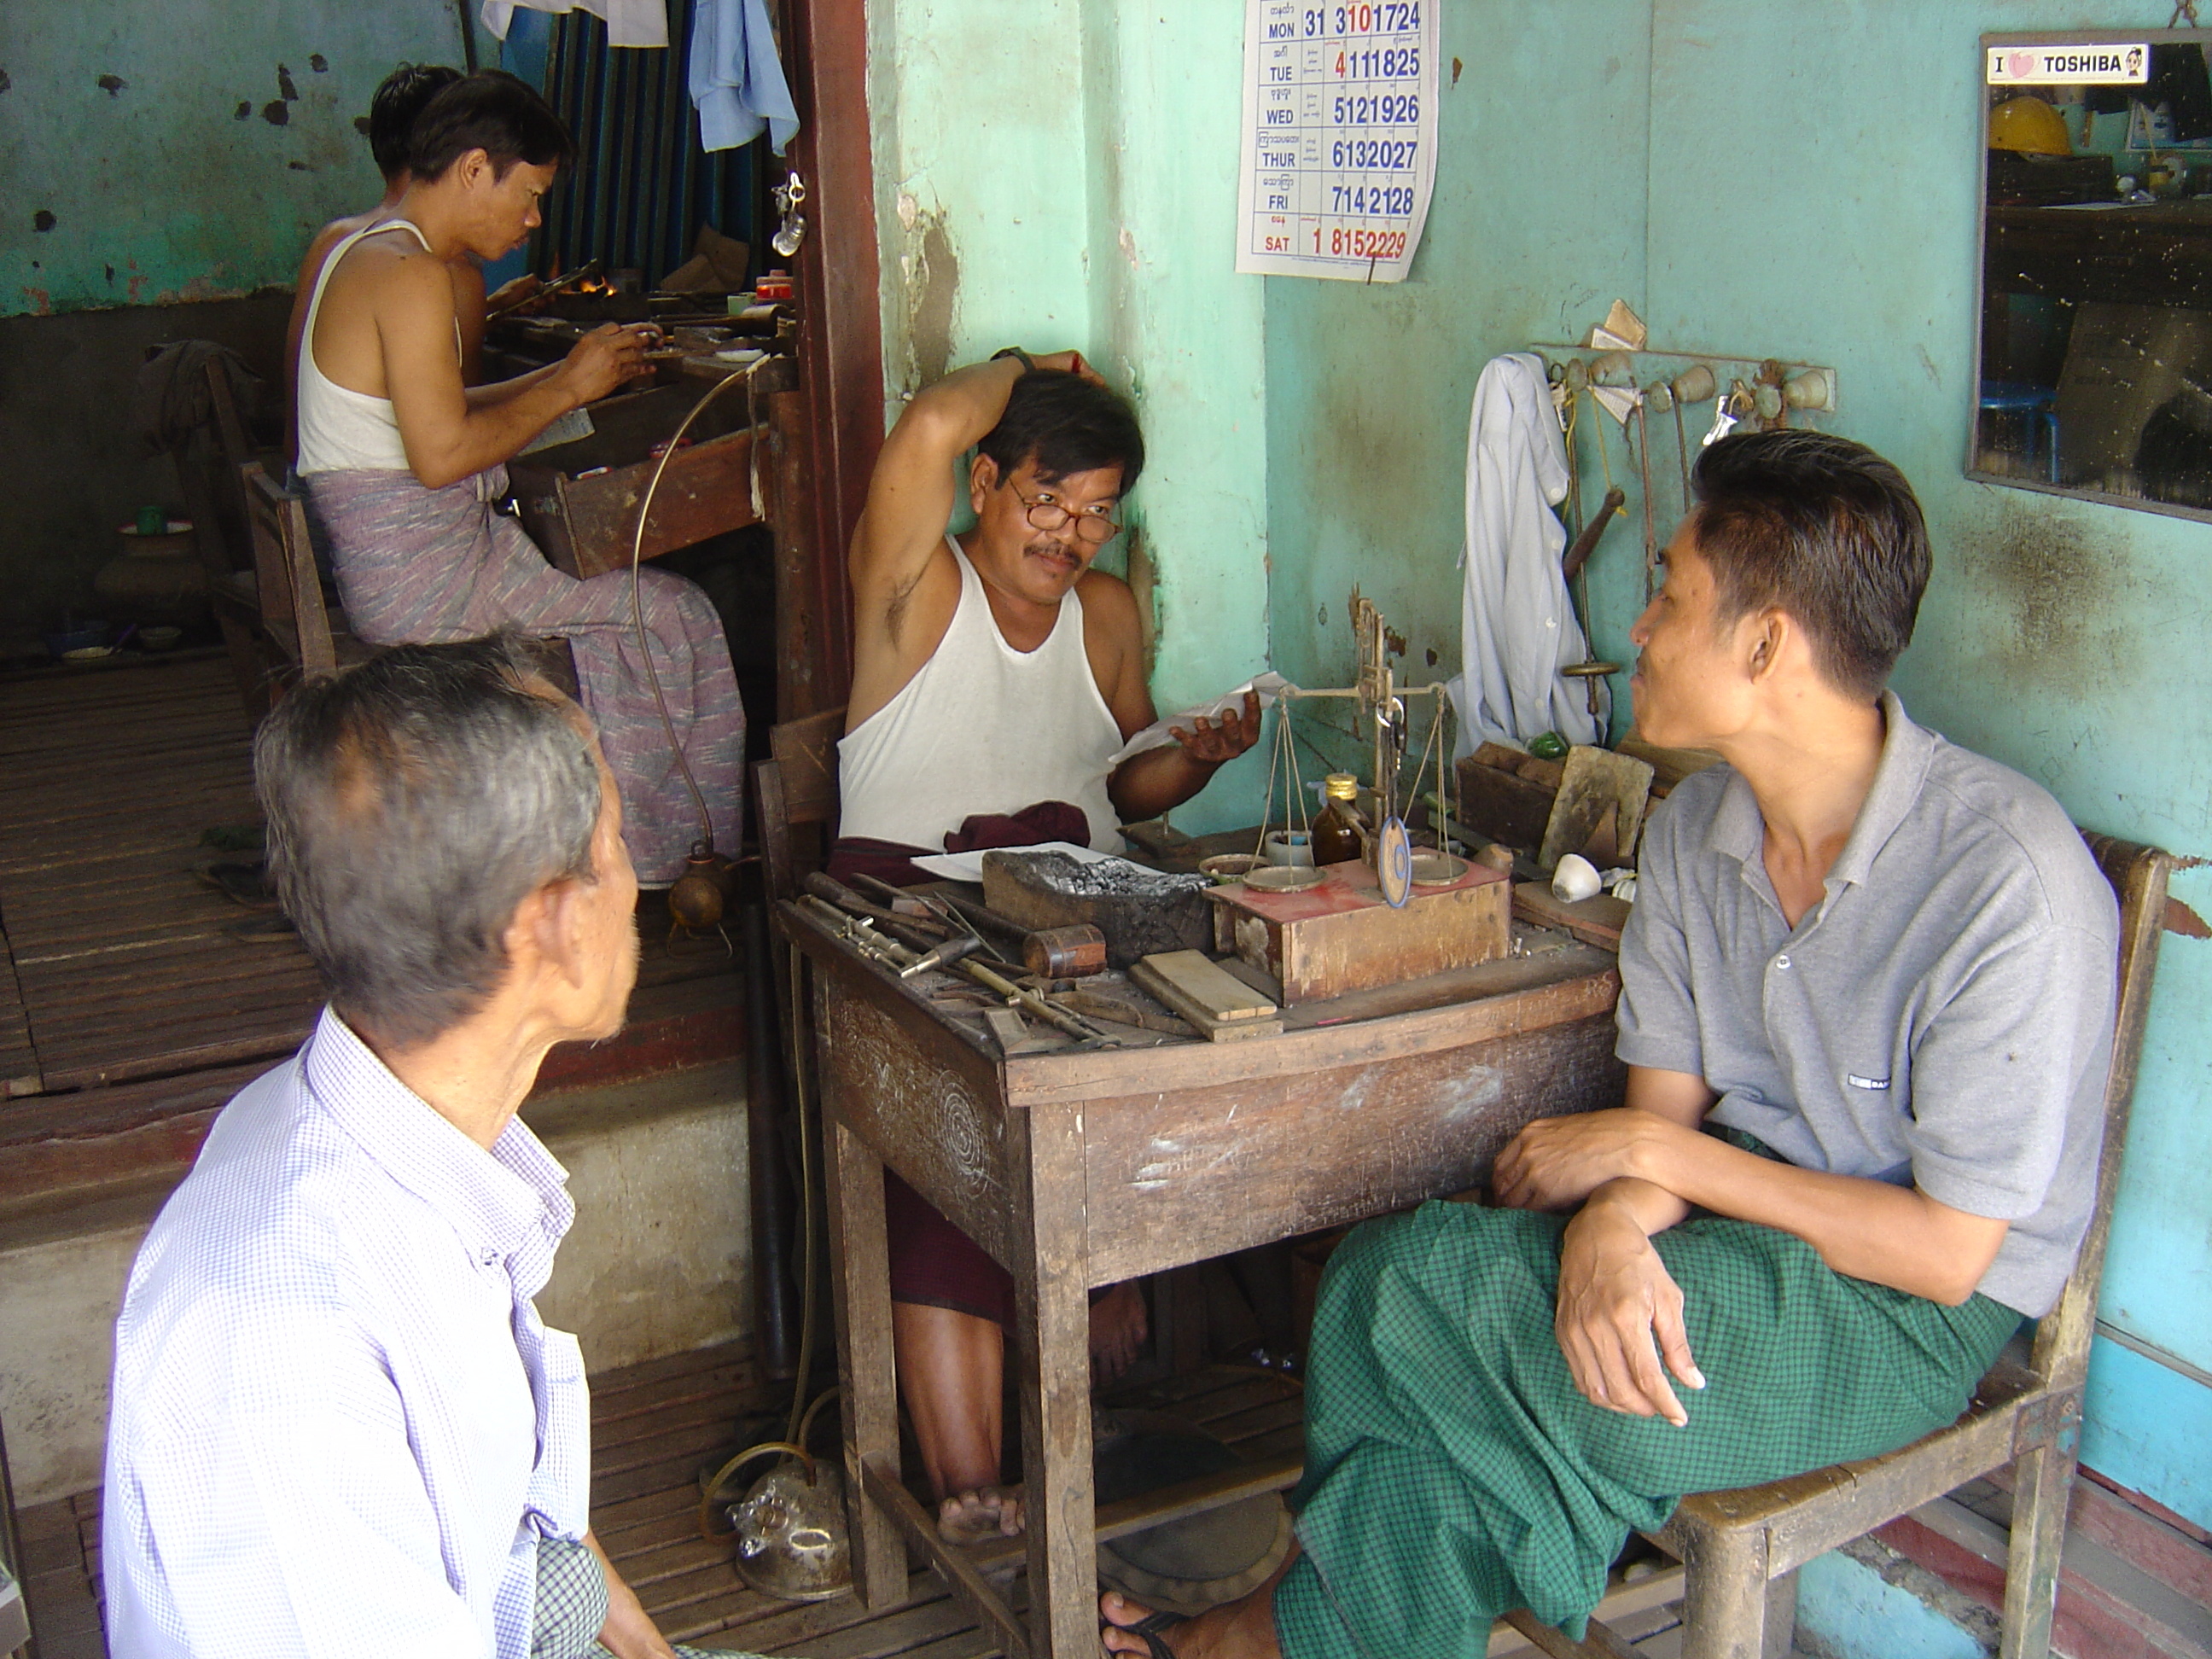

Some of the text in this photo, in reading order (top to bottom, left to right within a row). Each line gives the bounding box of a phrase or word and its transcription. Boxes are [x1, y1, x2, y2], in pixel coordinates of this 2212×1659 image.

[1269, 1, 1419, 38] MON 31 3 10 17 24
[1270, 49, 1419, 81] TUE 4 11 18 25
[1995, 55, 2122, 73] I TOSHIBA
[1267, 96, 1418, 124] WED 5 12 19 26
[1263, 141, 1417, 167] THUR 6 13 20 27
[1269, 187, 1413, 214] FRI 7 14 21 28
[1266, 229, 1406, 259] SAT 1 8 15 22 29
